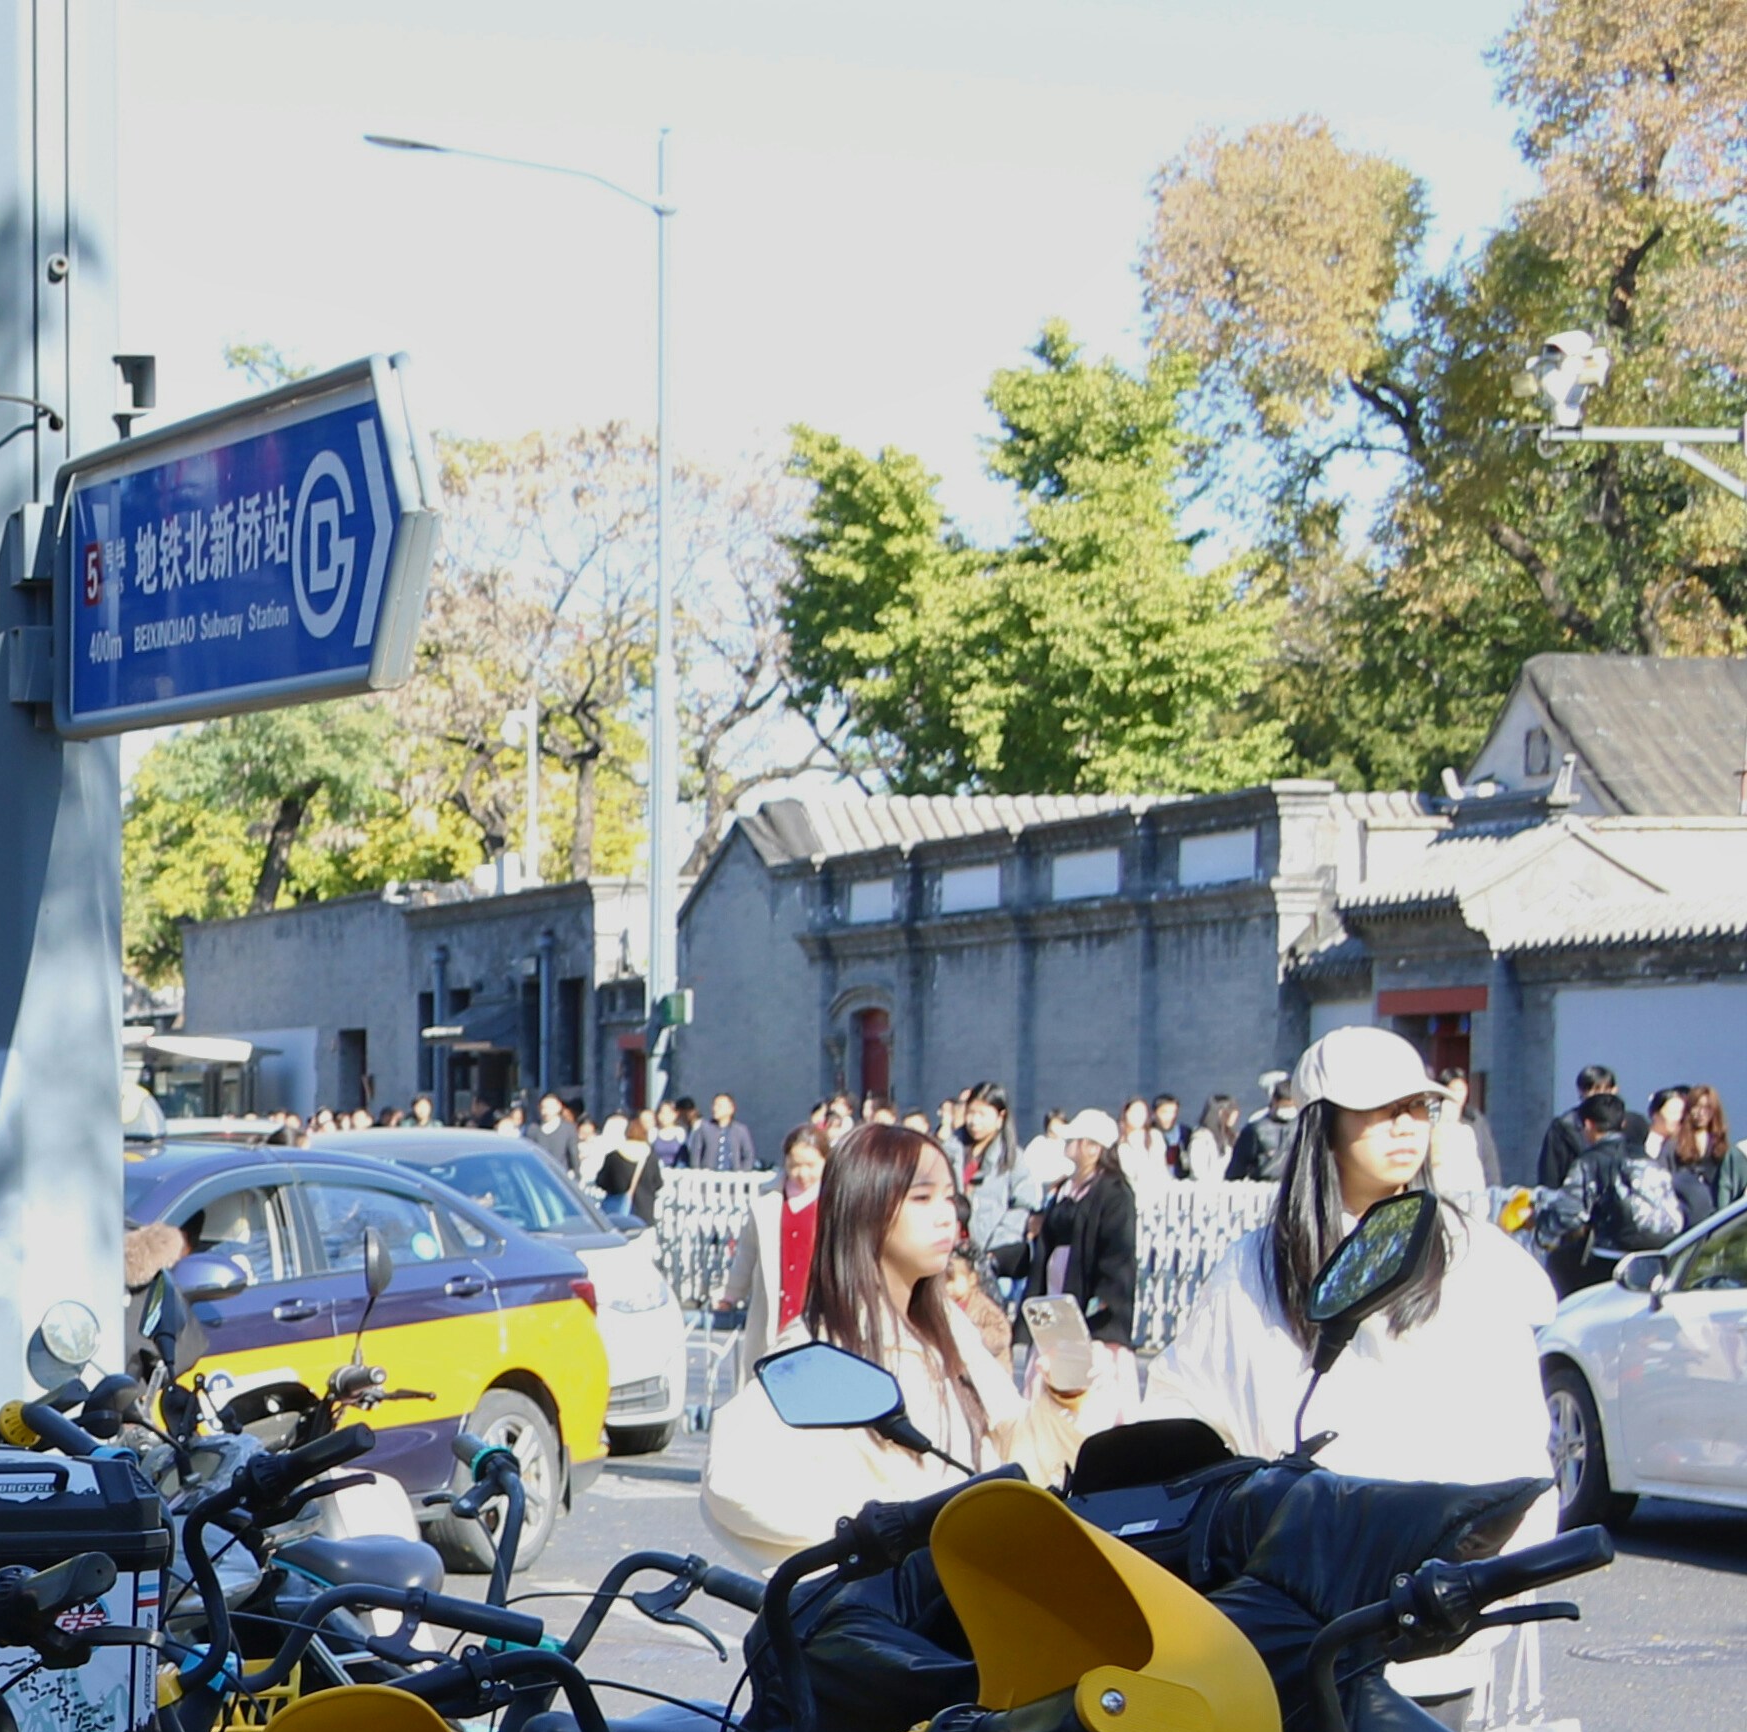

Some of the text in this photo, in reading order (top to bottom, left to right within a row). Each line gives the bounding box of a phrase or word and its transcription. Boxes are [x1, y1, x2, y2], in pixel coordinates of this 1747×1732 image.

[134, 484, 290, 594] 地铁北新桥站
[86, 551, 99, 599] 5
[89, 631, 122, 664] 400m
[134, 600, 289, 653] BEIXINQIAO Subway Station
